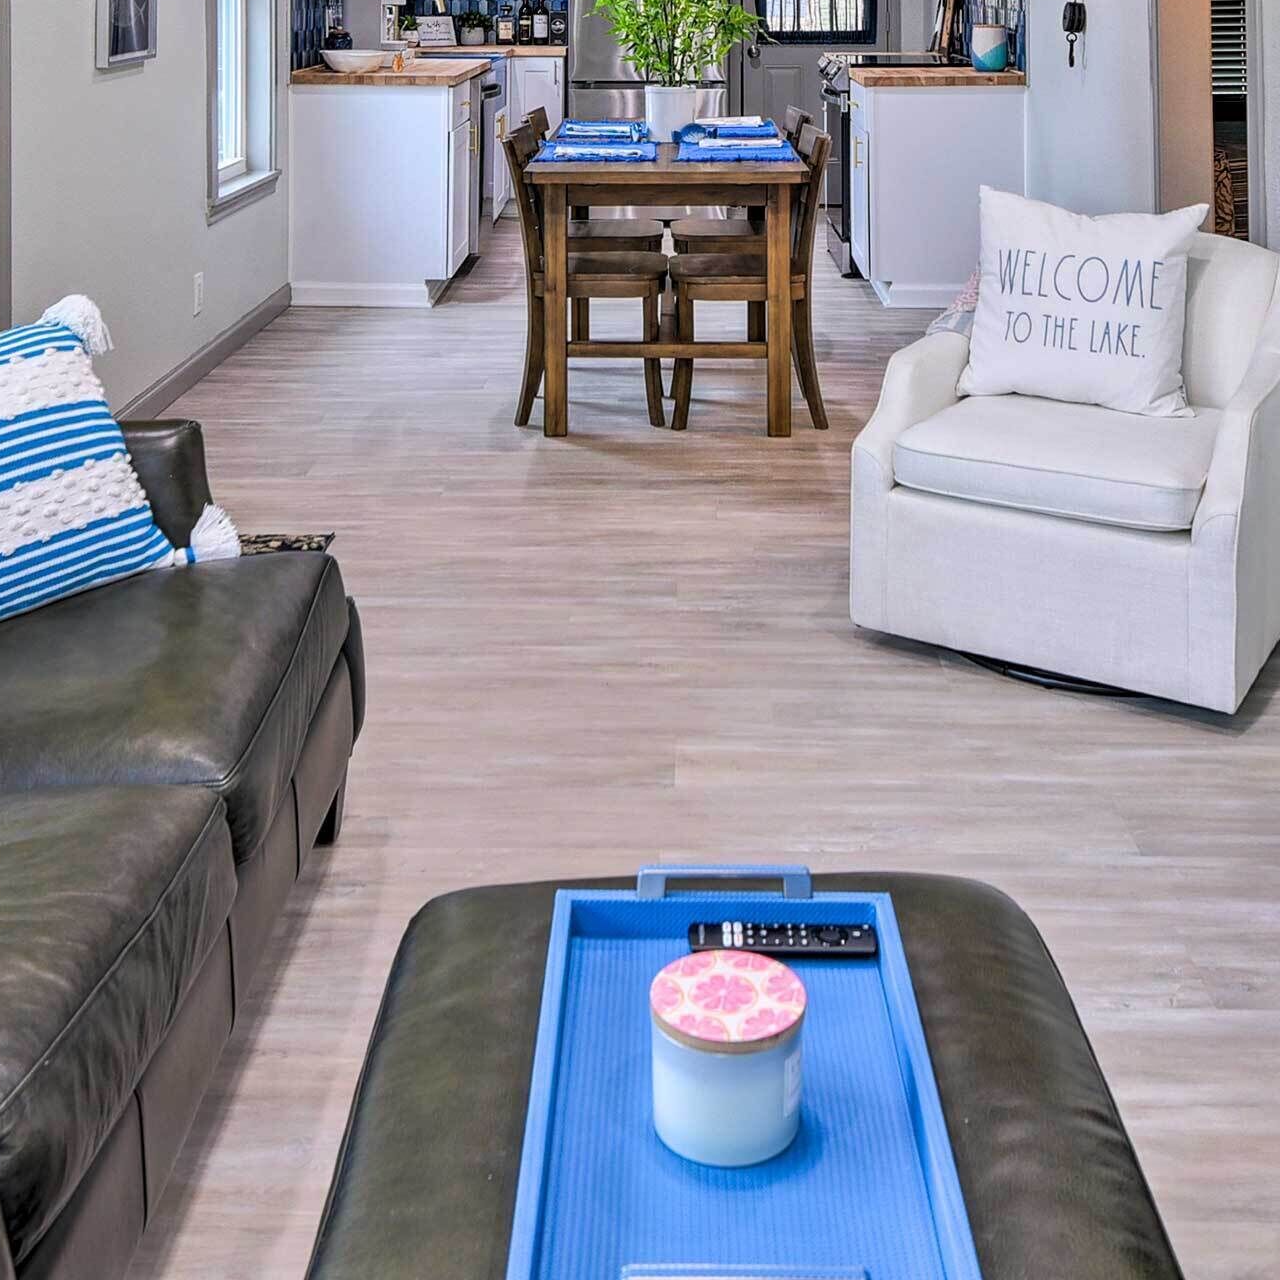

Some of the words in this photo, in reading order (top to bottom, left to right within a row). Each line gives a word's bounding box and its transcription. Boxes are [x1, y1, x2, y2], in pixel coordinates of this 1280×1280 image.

[998, 248, 1164, 310] WELCOME
[1004, 311, 1032, 343] TO
[1043, 314, 1078, 351] THE
[1089, 320, 1146, 359] LAKE.
